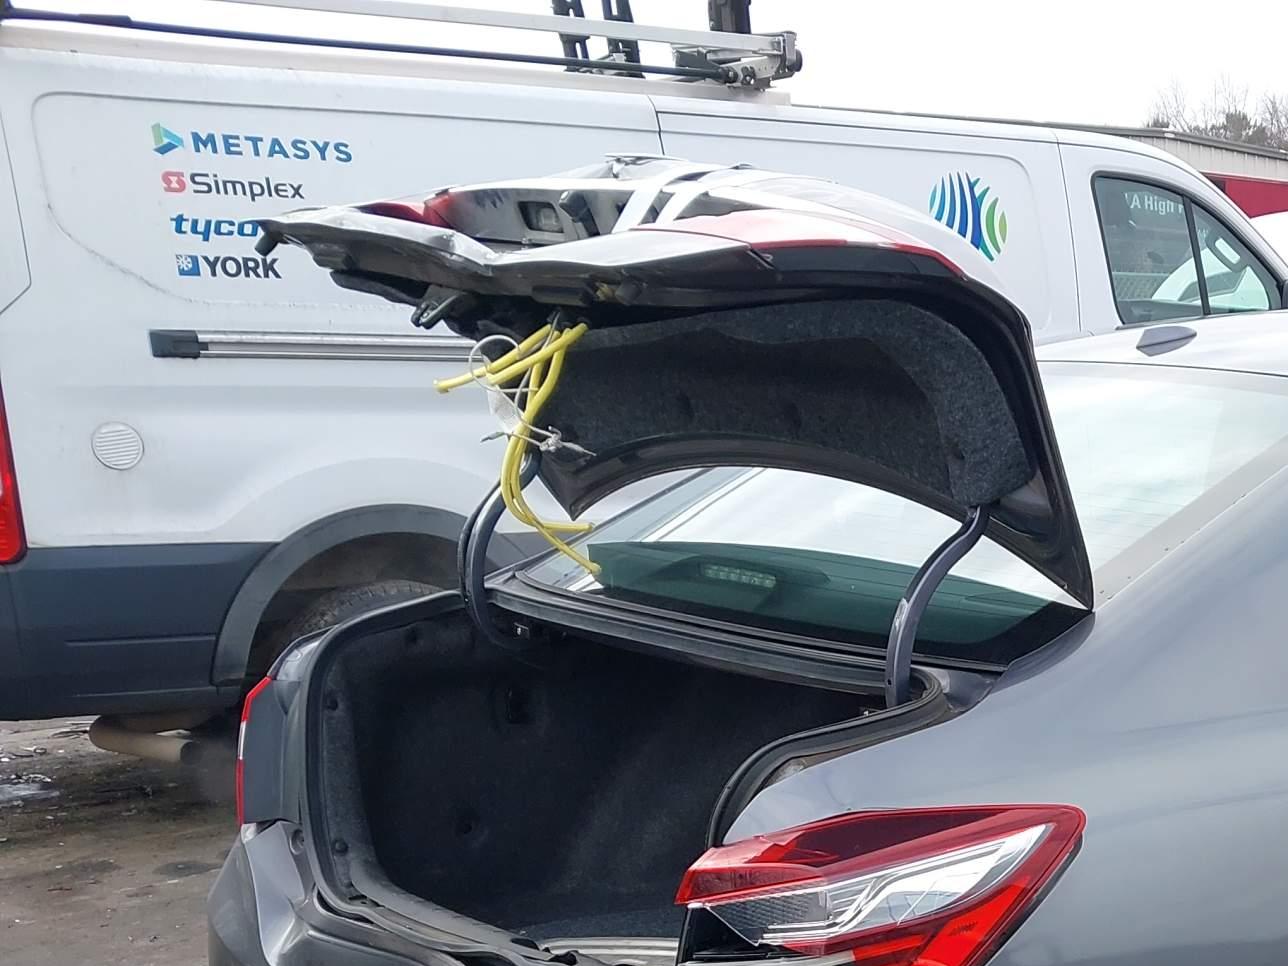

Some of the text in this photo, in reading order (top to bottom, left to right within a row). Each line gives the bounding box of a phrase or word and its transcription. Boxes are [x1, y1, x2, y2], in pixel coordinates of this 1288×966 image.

[190, 131, 353, 163] METASYS
[189, 172, 305, 202] Simplex
[1144, 195, 1175, 216] High
[170, 213, 259, 242] tyco
[200, 255, 282, 279] YORK
